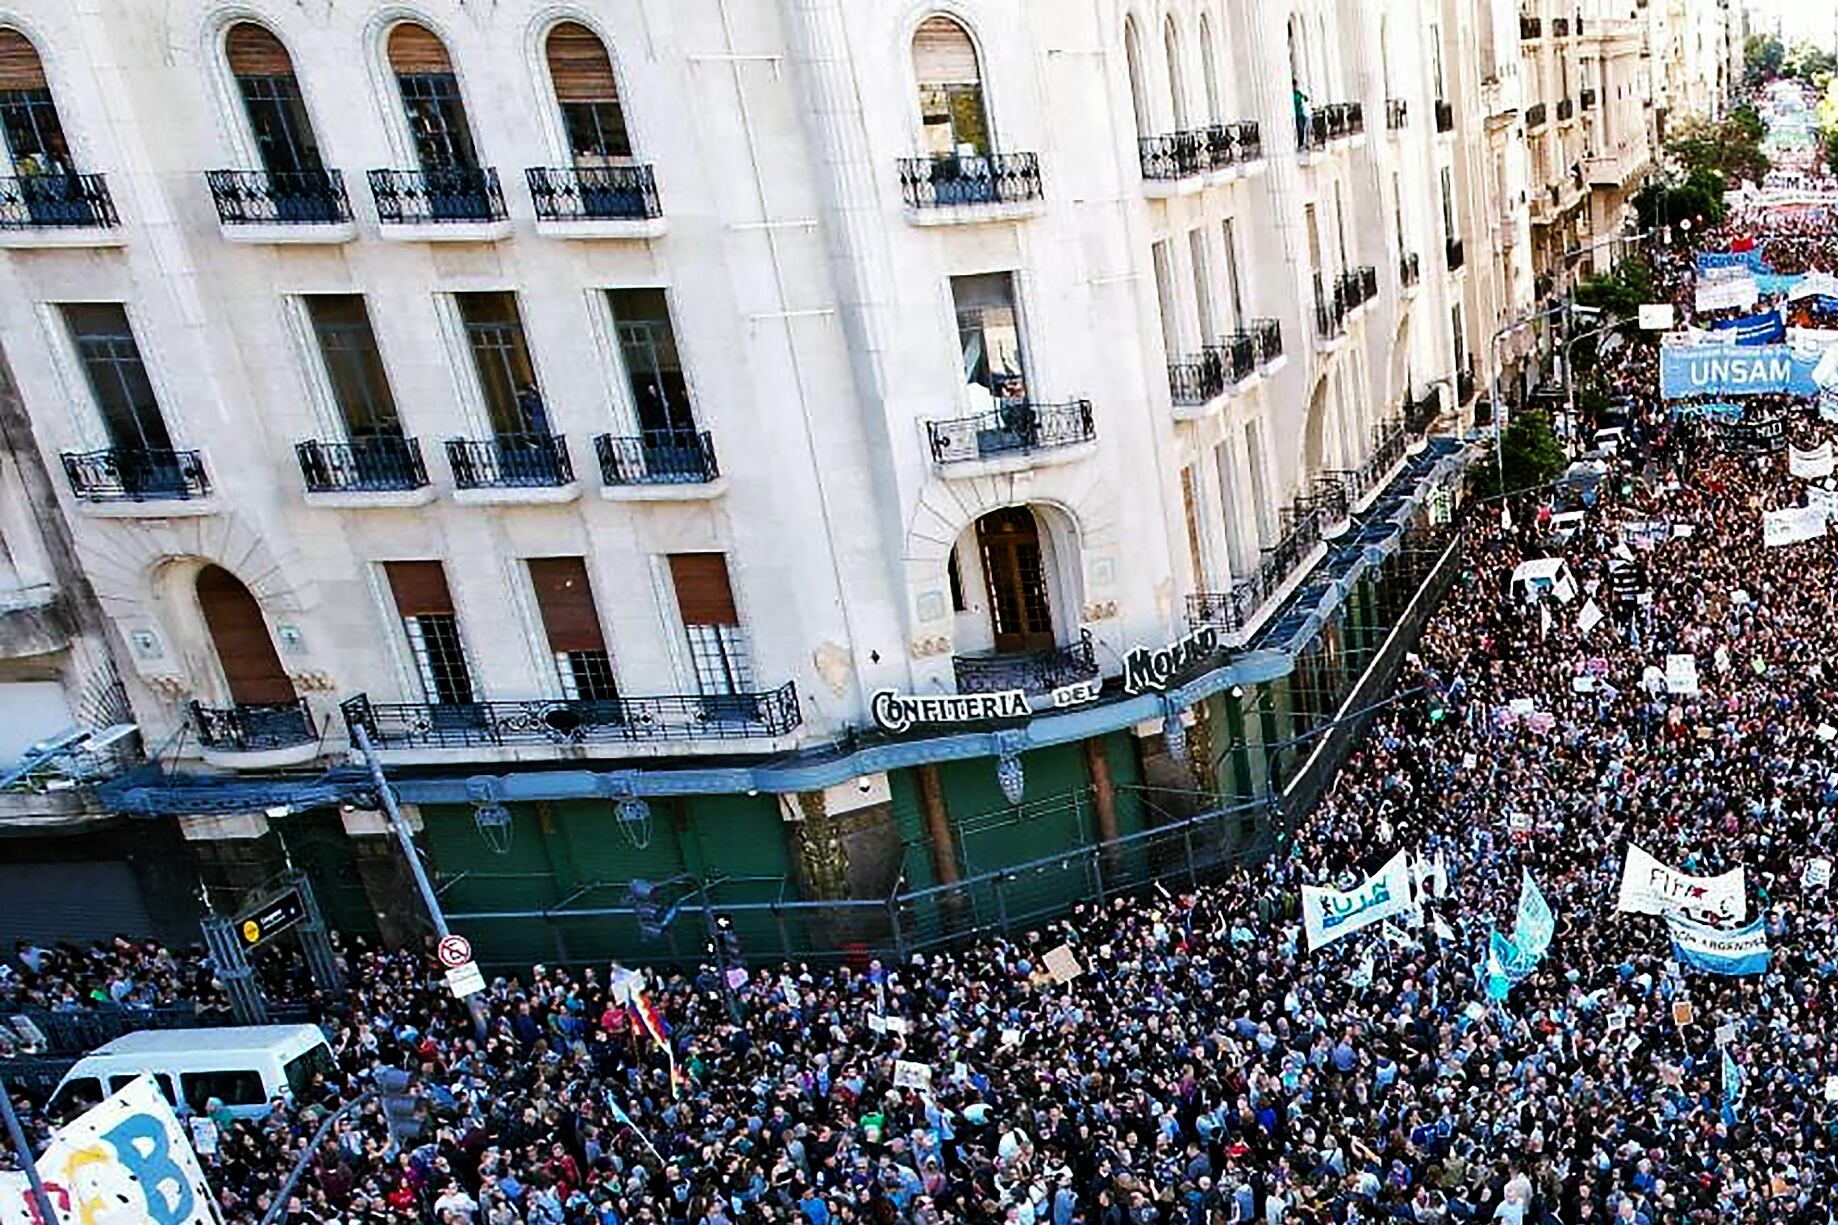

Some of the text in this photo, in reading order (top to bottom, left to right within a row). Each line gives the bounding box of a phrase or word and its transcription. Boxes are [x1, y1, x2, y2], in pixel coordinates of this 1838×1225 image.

[1691, 360, 1791, 384] UNSAM
[872, 626, 1218, 733] CONFITERIA DEL MOLINO
